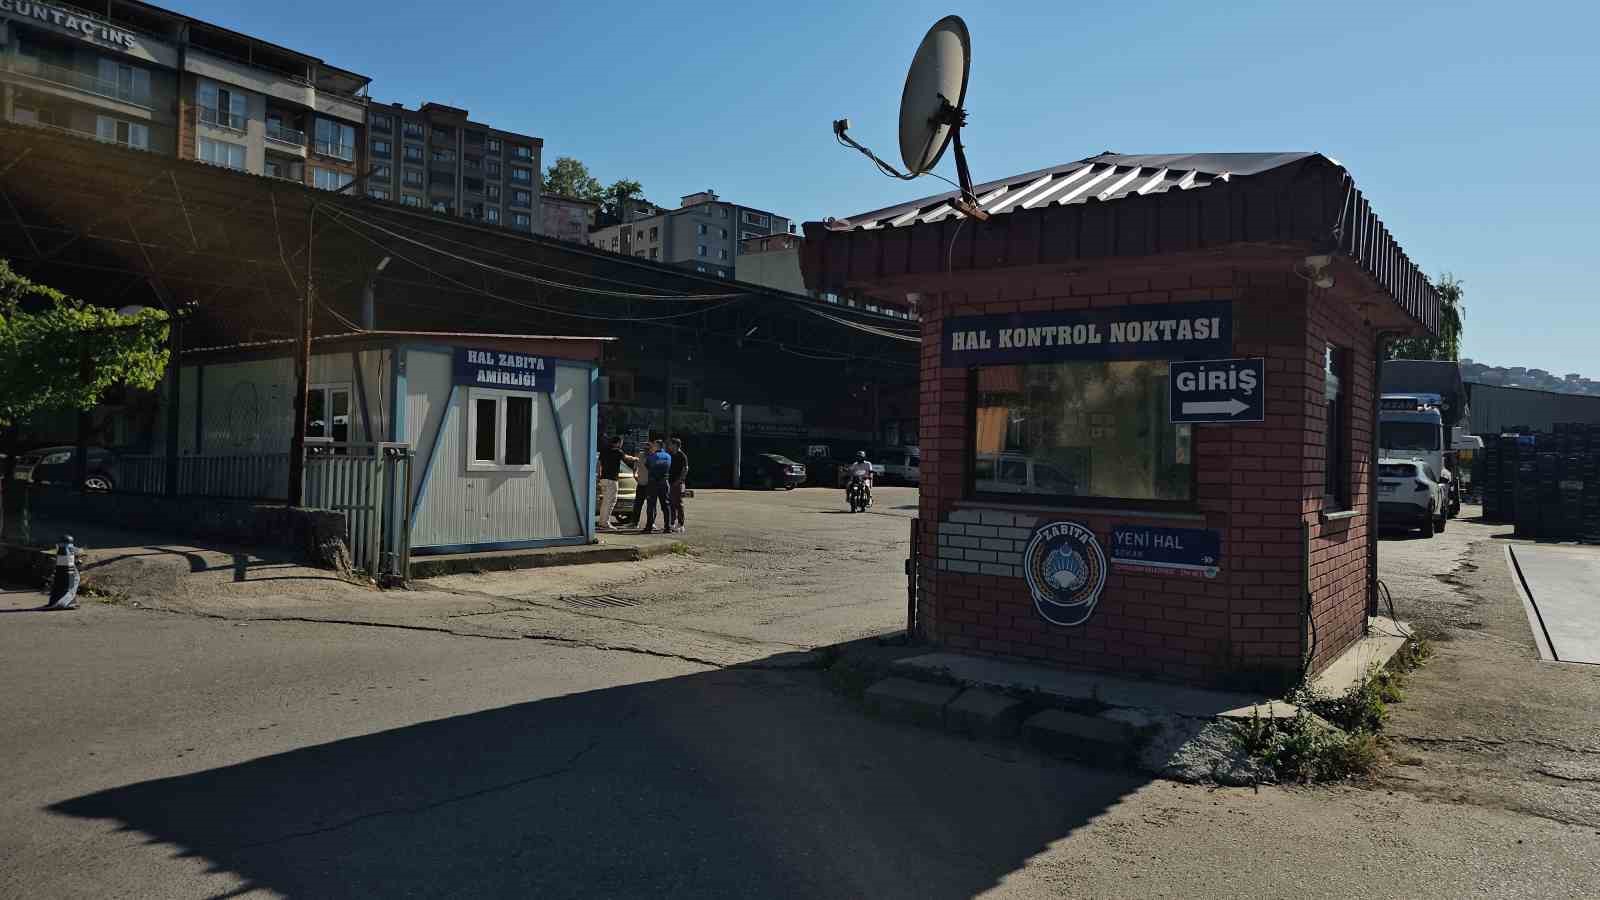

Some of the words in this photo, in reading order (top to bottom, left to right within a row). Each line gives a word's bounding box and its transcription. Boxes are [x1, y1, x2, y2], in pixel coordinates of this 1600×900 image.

[951, 330, 991, 351] HAL
[998, 324, 1101, 349] KONTROL
[1109, 318, 1220, 343] NOKTASI
[467, 350, 495, 365] HAL
[498, 353, 545, 370] ZABITA
[476, 368, 536, 387] AMİRLİĞİ
[1176, 364, 1257, 396] GİRİŞ
[1042, 524, 1090, 545] ZABITA
[1115, 531, 1149, 547] YENİ
[1154, 534, 1185, 550] HAL
